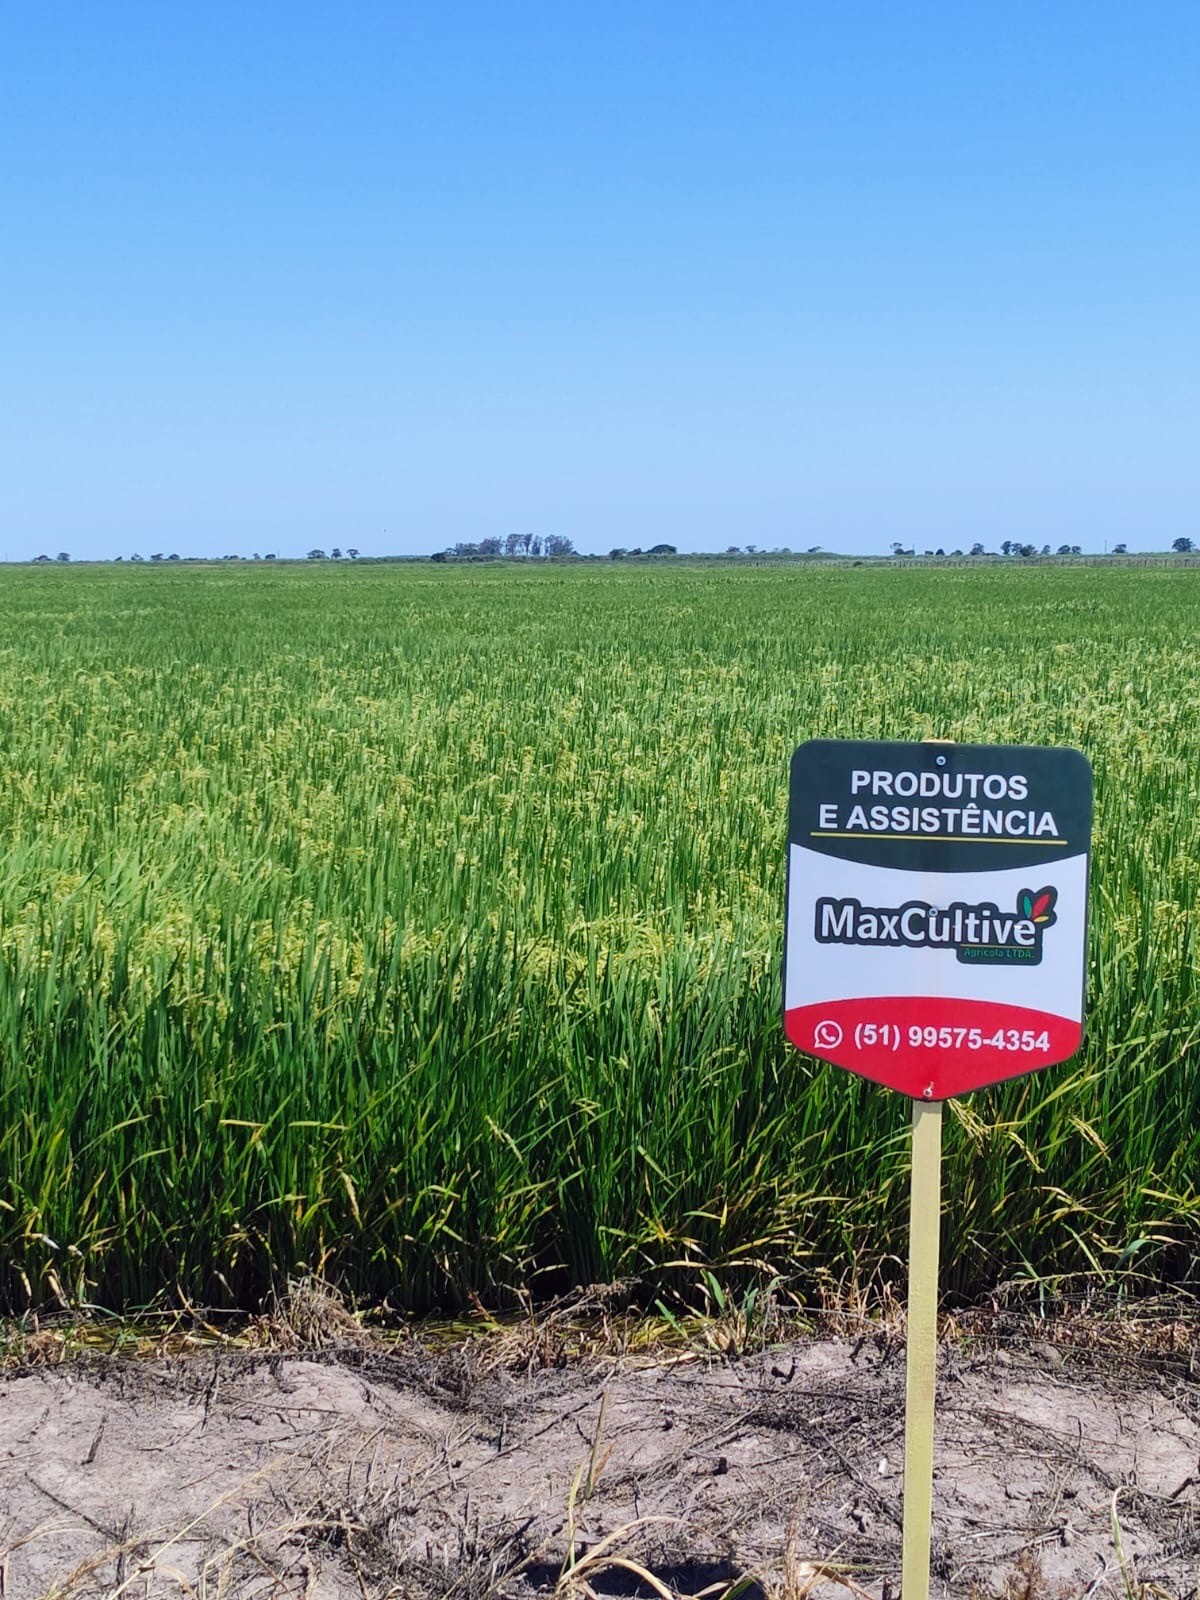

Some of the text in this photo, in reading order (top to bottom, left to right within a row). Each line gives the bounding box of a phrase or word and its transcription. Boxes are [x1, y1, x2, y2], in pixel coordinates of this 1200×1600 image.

[851, 770, 1028, 800] PRODUTOS
[819, 803, 1059, 836] E ASSISTÊNCIA
[821, 904, 1036, 945] MaxCultive
[854, 1025, 1050, 1051] (51) 99575-4354
